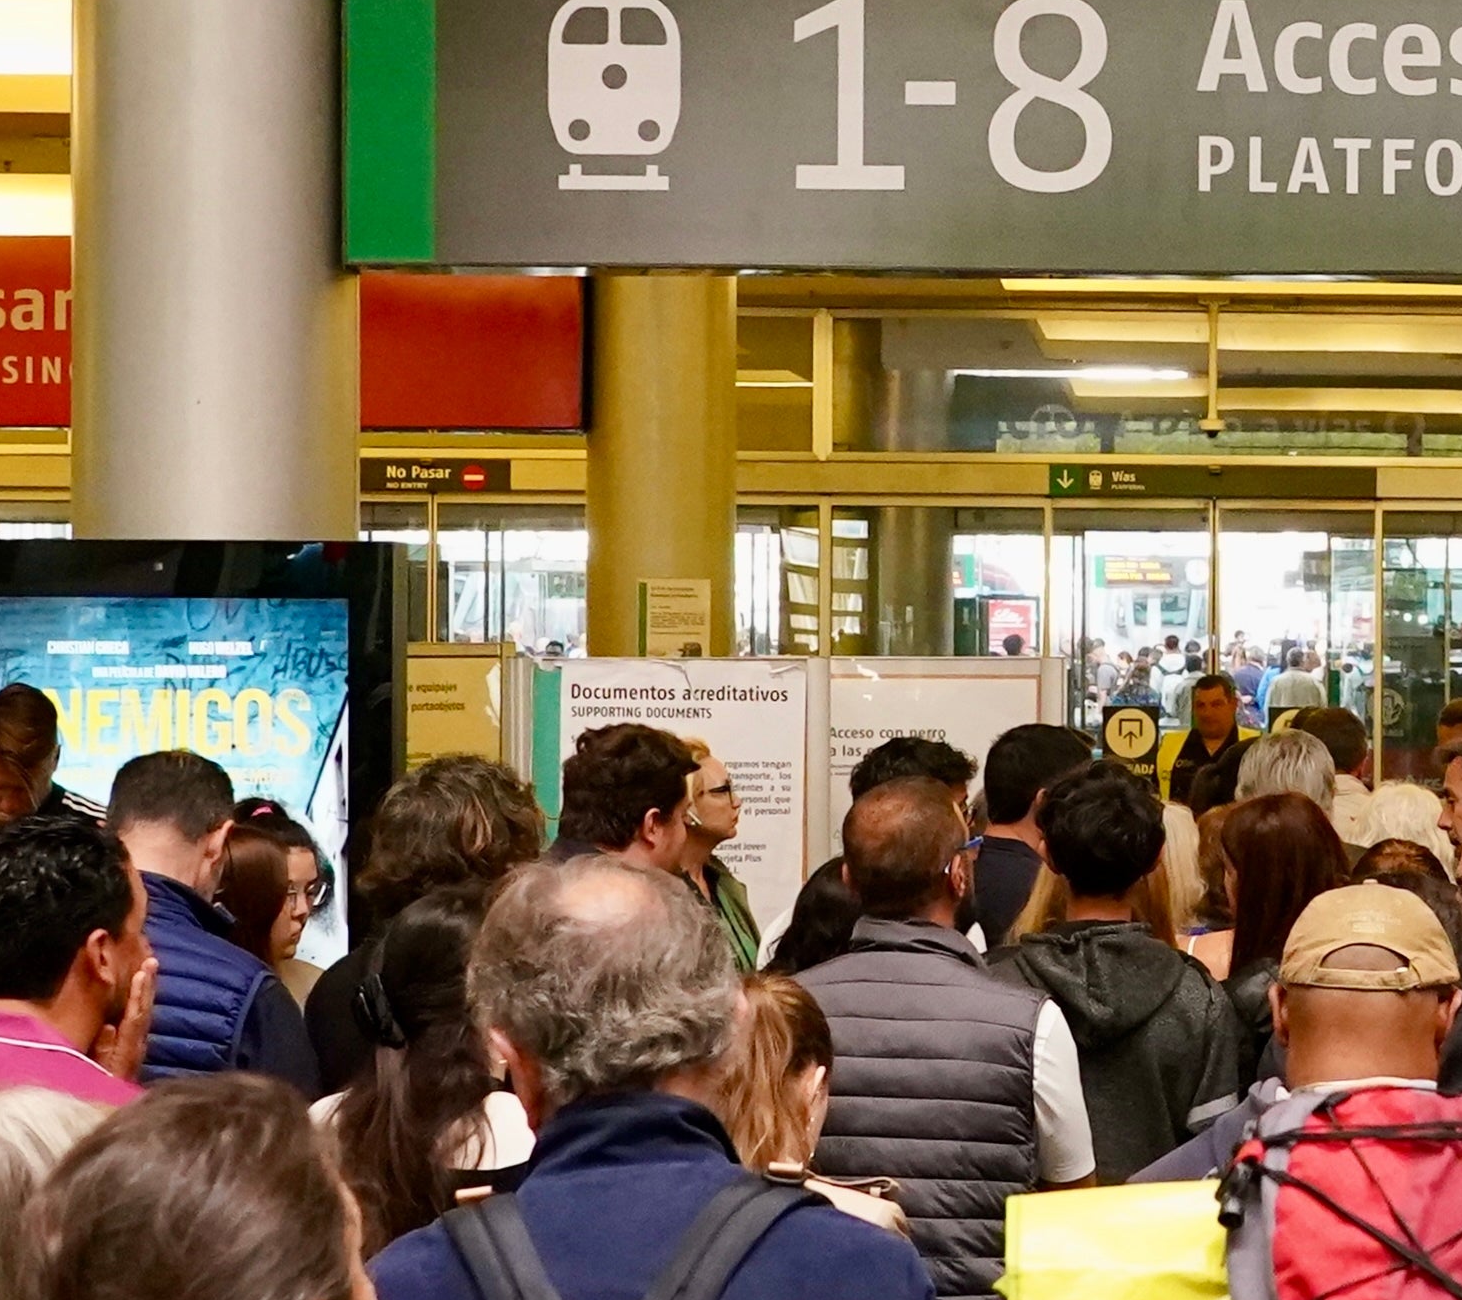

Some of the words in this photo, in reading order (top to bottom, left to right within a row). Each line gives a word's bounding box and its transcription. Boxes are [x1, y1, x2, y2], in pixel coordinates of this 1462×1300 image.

[385, 464, 409, 480] No
[412, 464, 452, 480] Pasar
[1111, 469, 1136, 483] Vías
[571, 683, 675, 701] Documentos
[682, 684, 788, 702] acreditativos
[571, 707, 641, 718] SUPPORTING
[646, 707, 712, 719] DOCUMENTS
[879, 728, 904, 739] con
[842, 744, 862, 757] las
